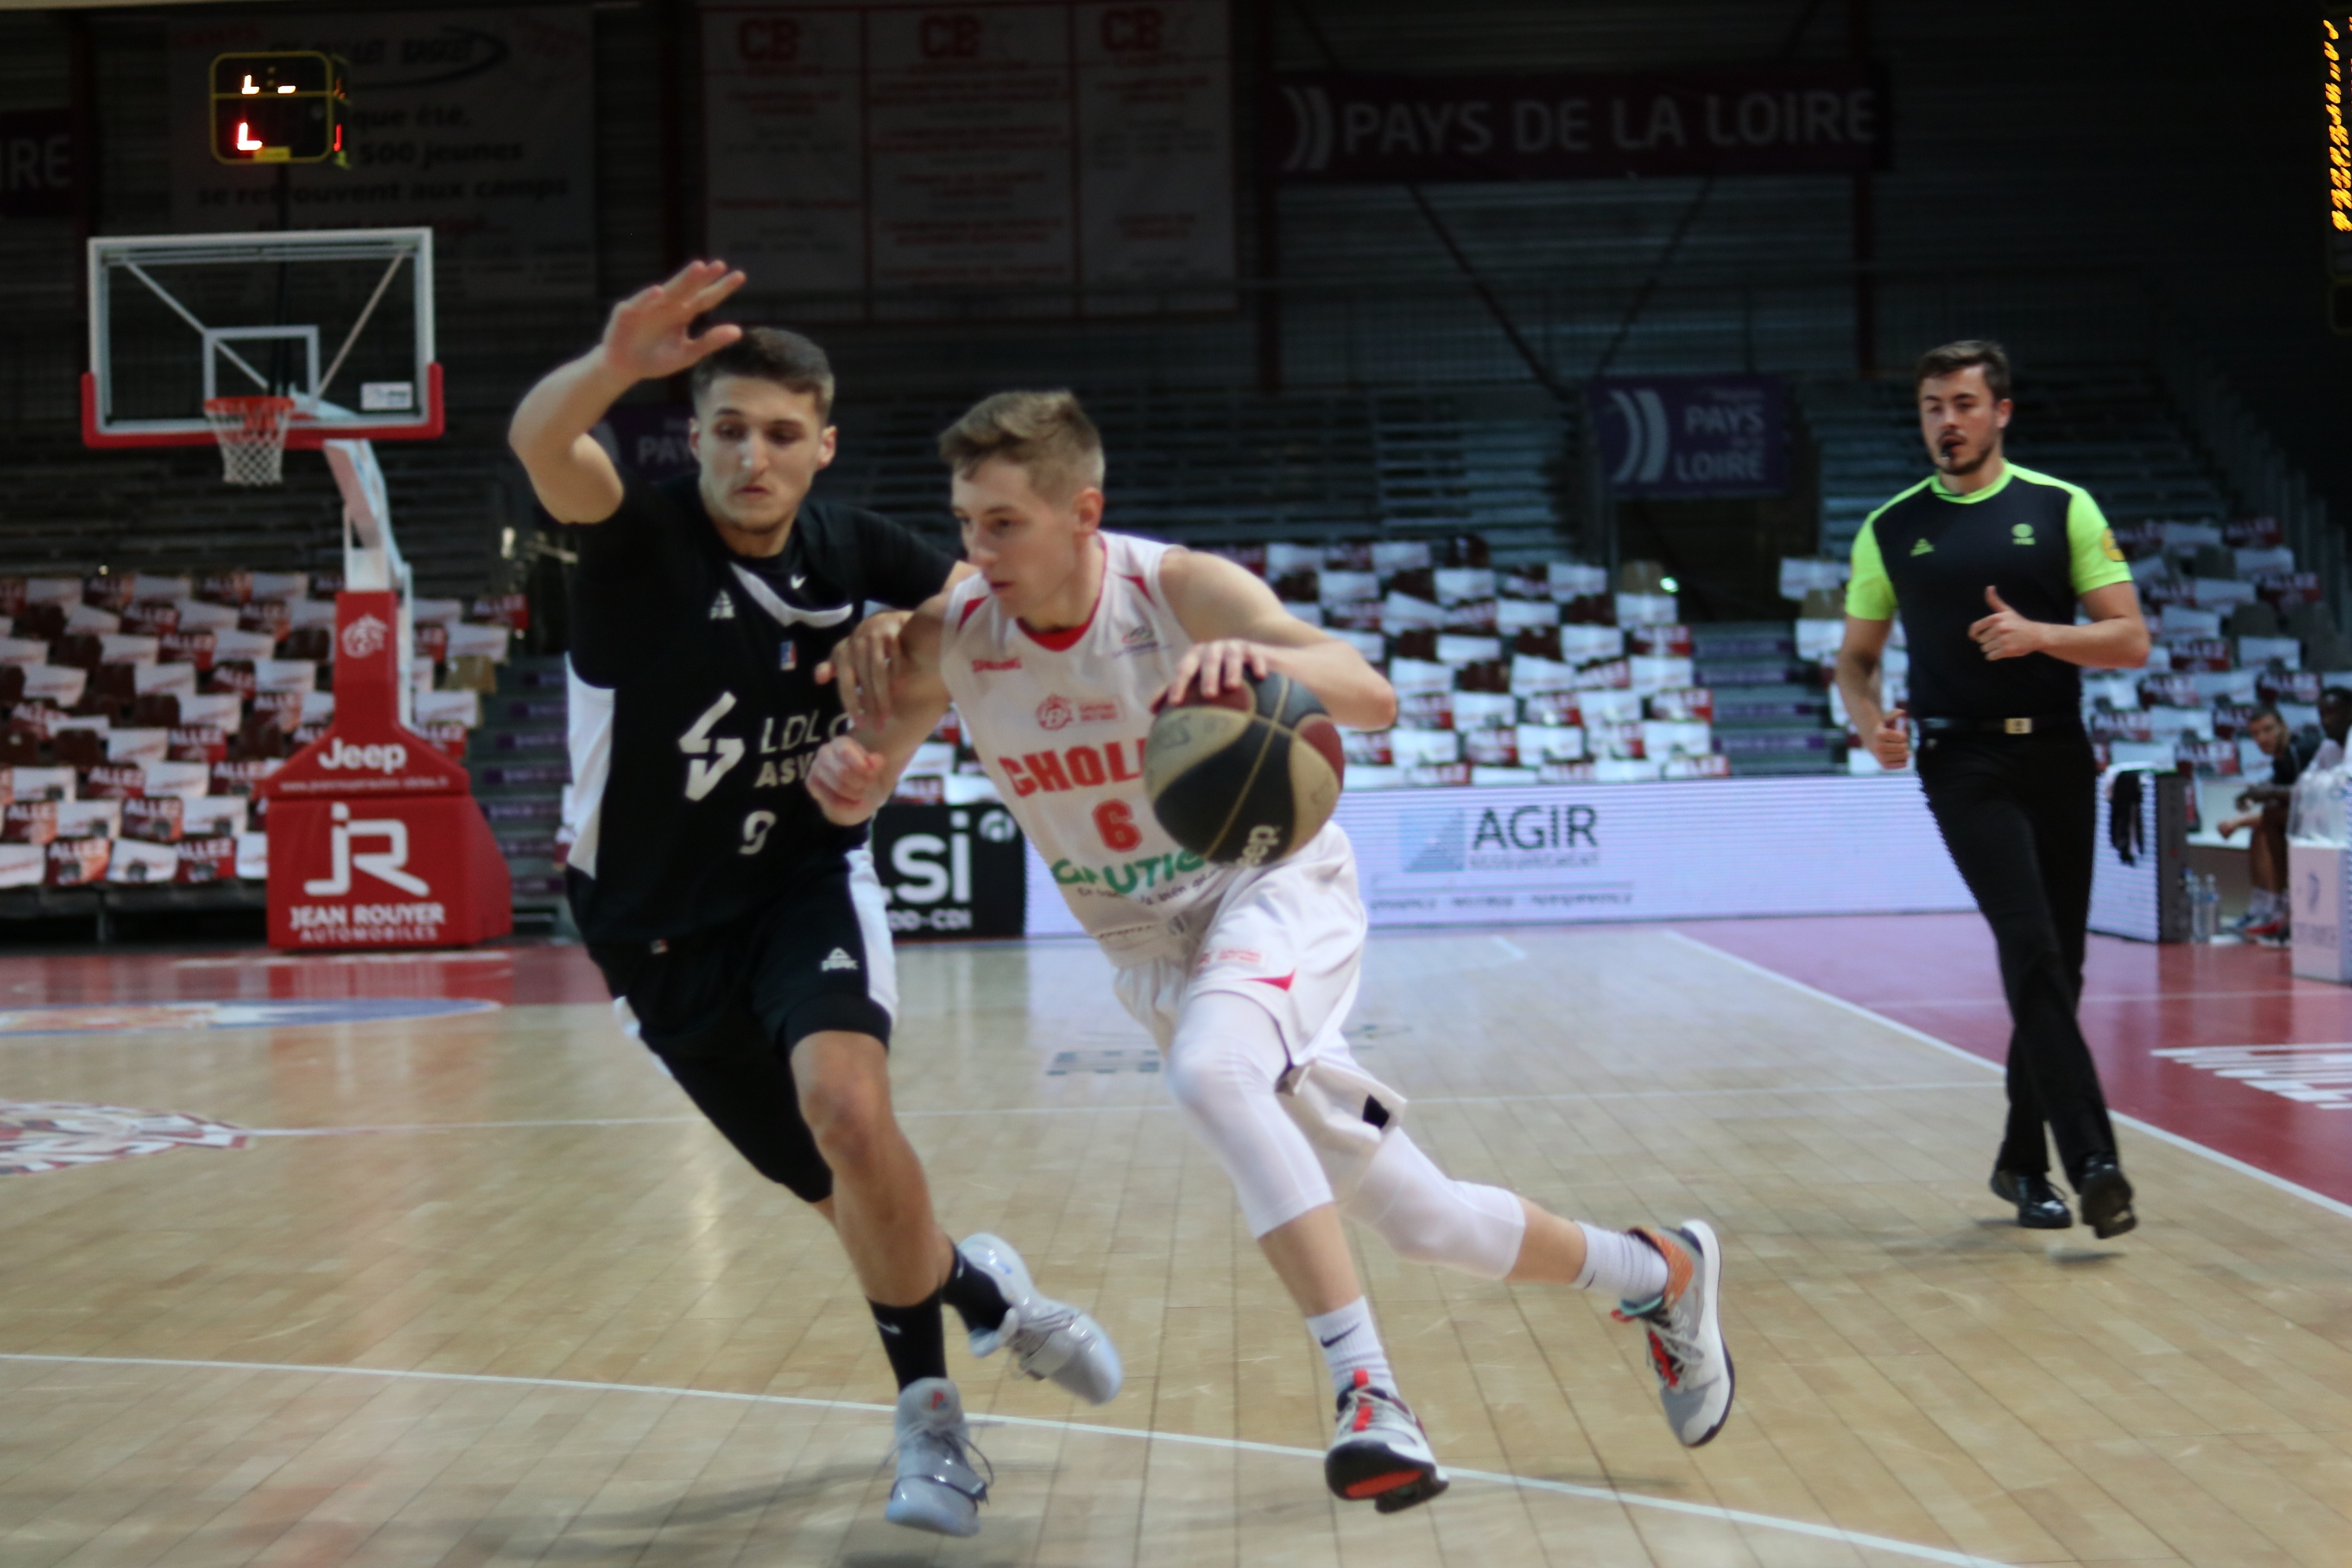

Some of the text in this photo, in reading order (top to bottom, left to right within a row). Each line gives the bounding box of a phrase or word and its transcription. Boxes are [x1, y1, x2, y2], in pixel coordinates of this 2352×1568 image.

[1344, 87, 1879, 156] PAYS DE LA LOIRE
[0, 134, 72, 191] RE
[1684, 404, 1766, 435] PAYS
[1674, 449, 1765, 484] LOIRE
[318, 737, 408, 775] Jeep
[737, 809, 778, 856] 9
[1091, 797, 1144, 853] 6
[1472, 805, 1600, 850] AGIR
[289, 902, 445, 931] JEAN ROUYER
[300, 925, 438, 942] AUTOMOBILES
